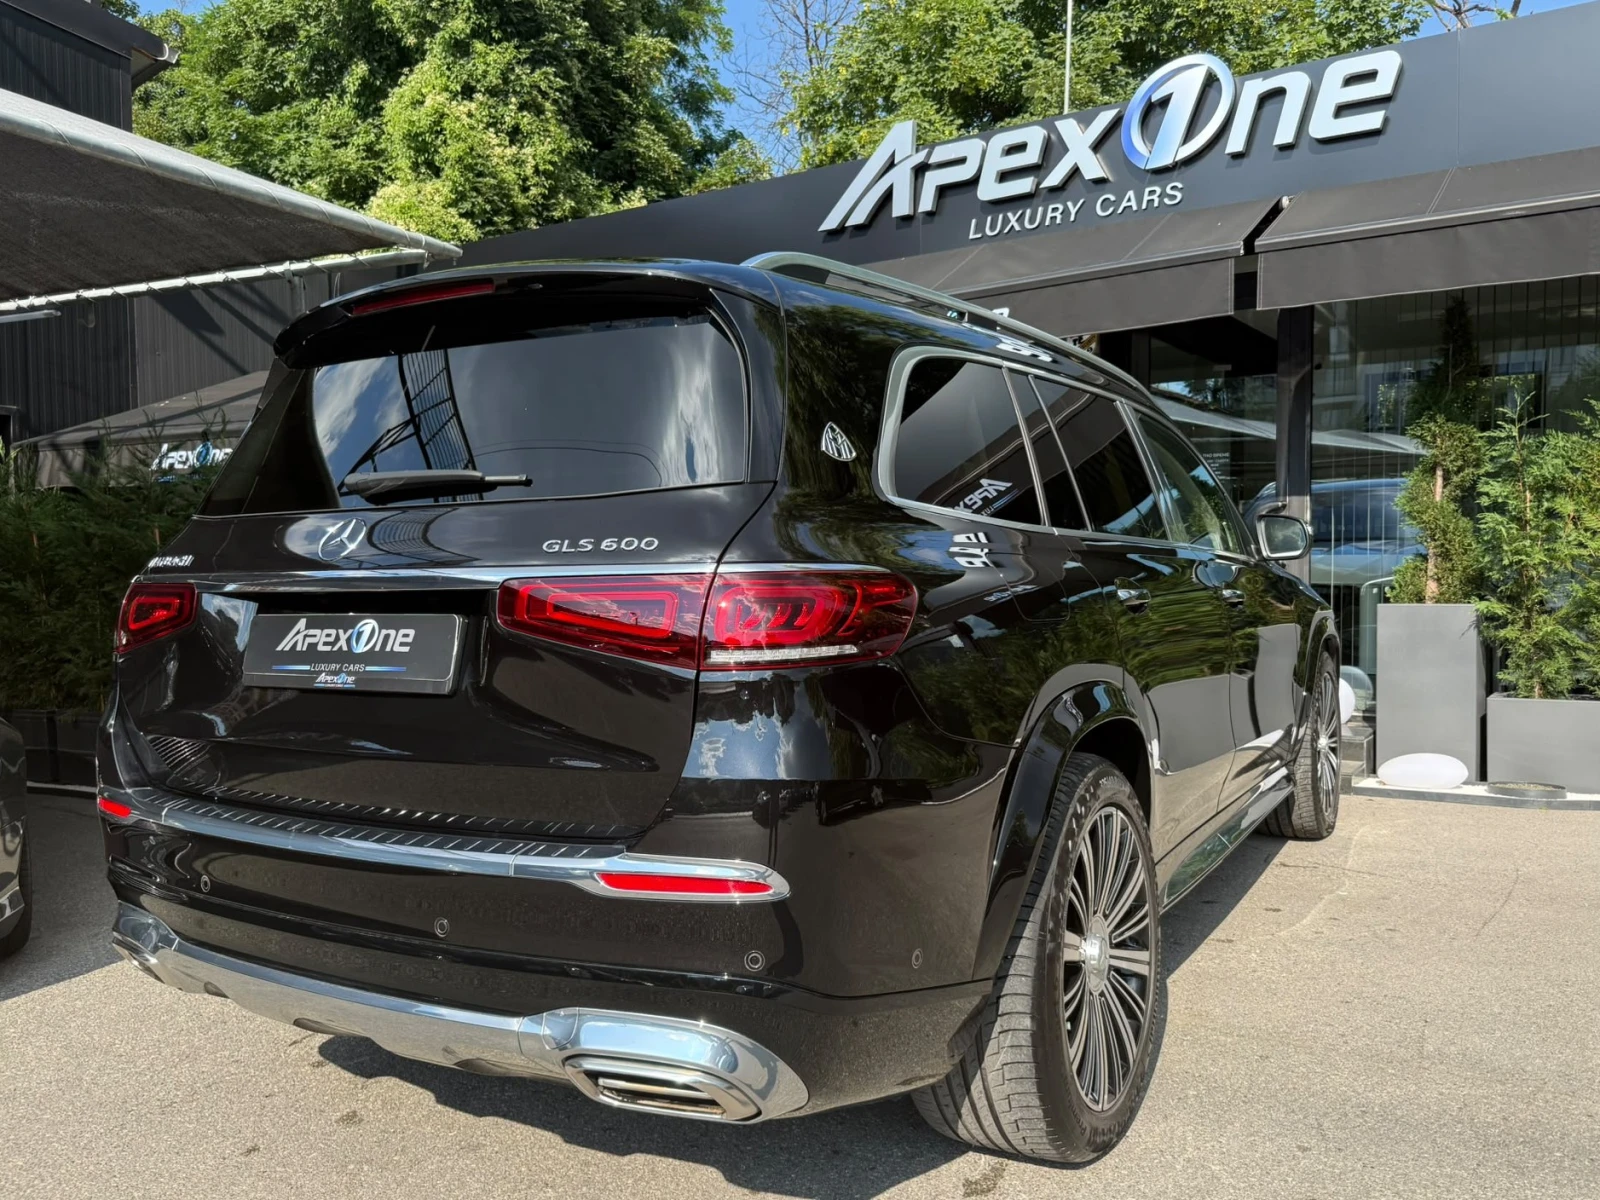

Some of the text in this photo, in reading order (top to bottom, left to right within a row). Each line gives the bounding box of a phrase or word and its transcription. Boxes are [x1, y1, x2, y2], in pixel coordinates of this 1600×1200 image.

[968, 181, 1184, 240] LUXURY CARS
[542, 537, 659, 553] GLS 600
[310, 663, 365, 672] LUXURY CARS
